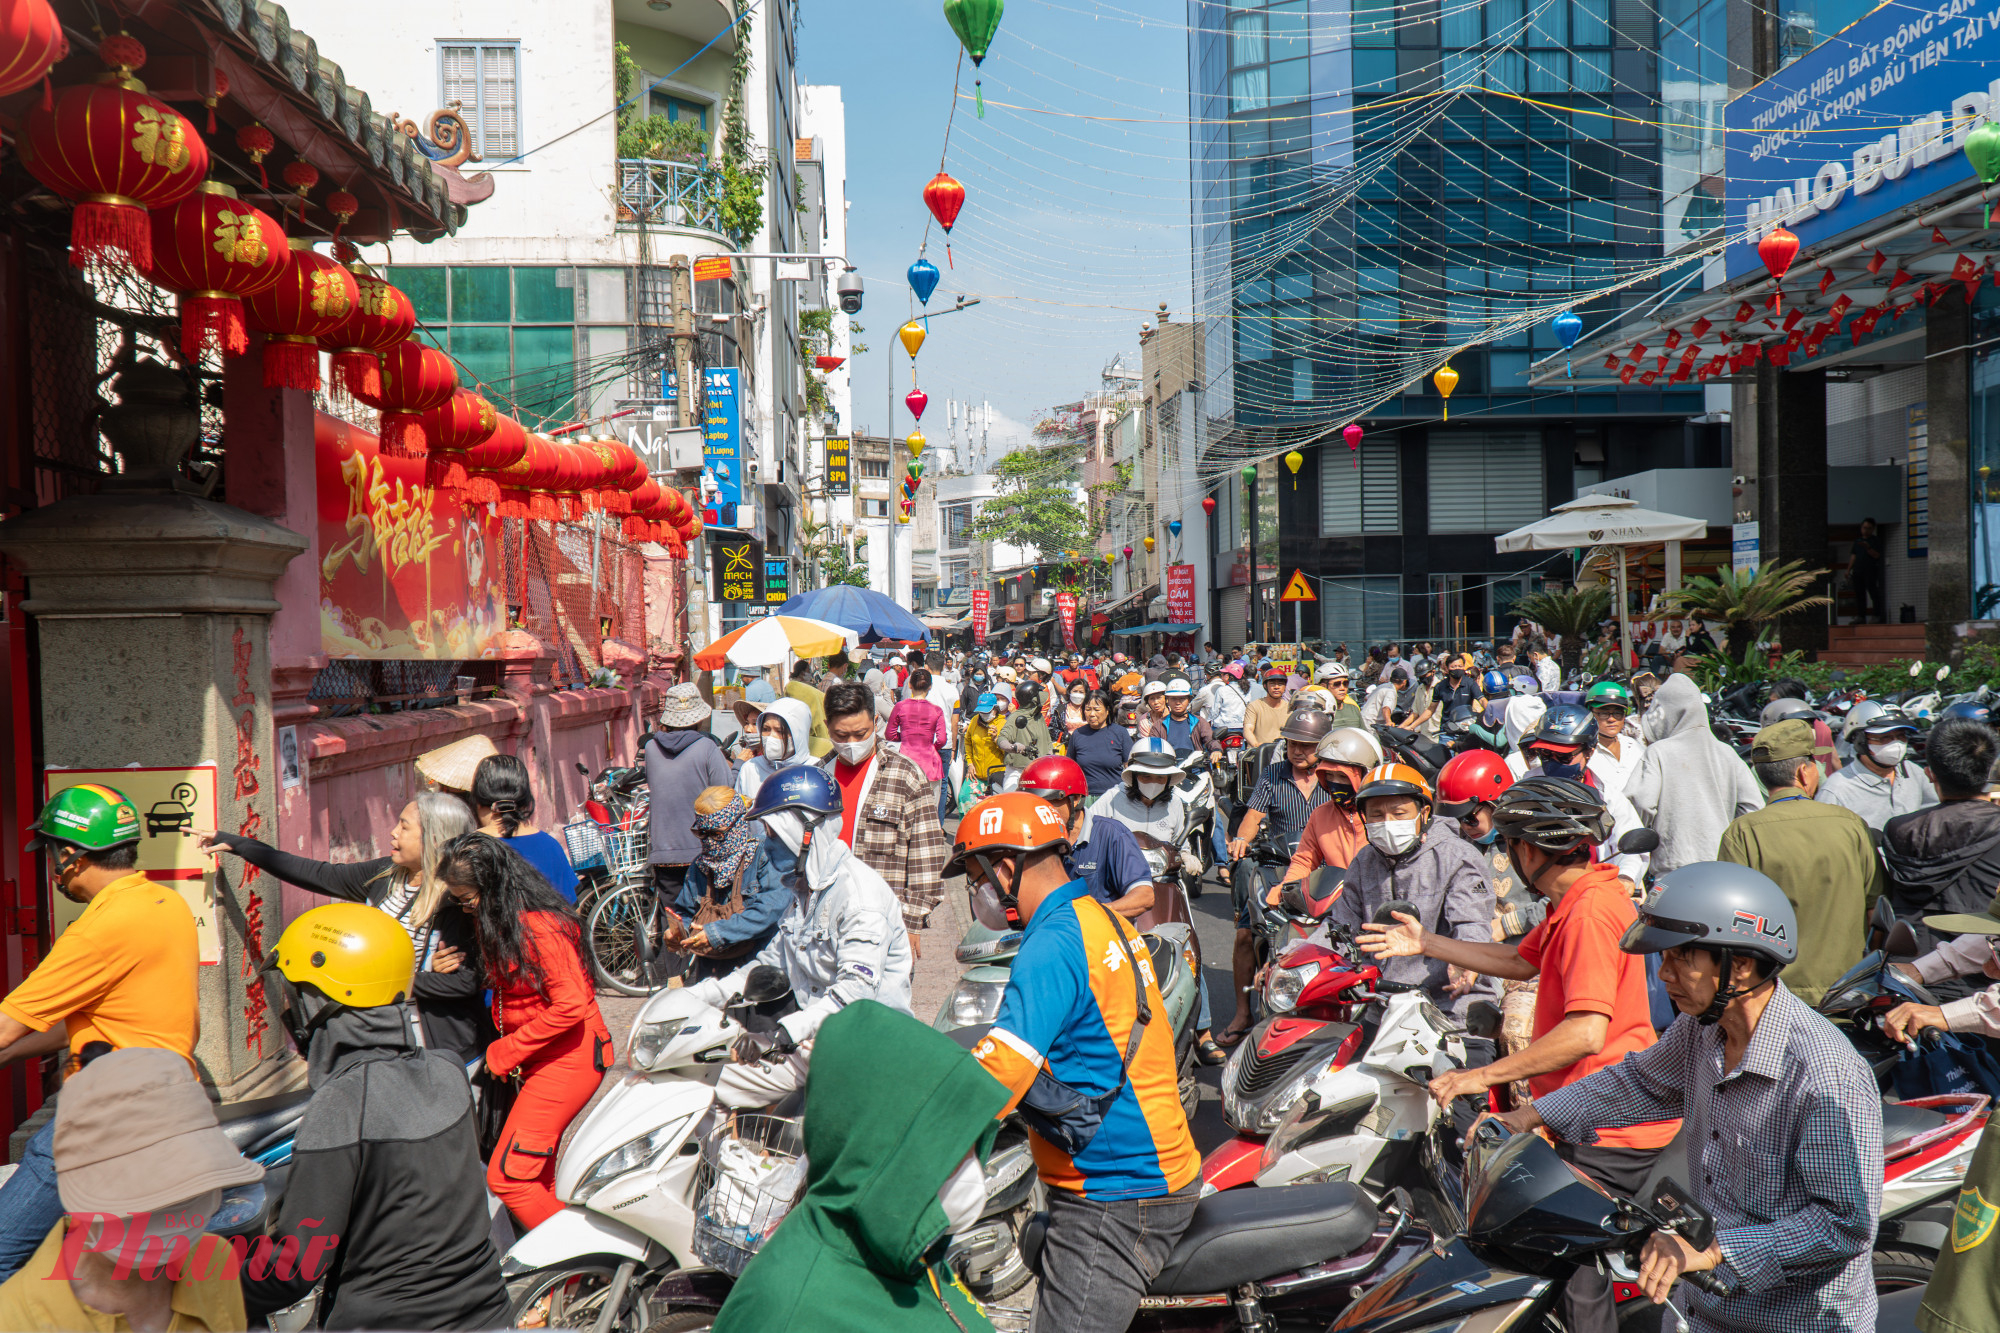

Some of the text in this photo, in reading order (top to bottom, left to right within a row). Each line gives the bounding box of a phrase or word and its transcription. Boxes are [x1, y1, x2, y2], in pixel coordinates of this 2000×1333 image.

[1752, 88, 1807, 132] THƯƠNG
[1811, 65, 1844, 100] HIỆU
[1849, 42, 1880, 78] BẤT
[1883, 12, 1934, 57] ĐỘNG
[1752, 133, 1790, 162] ĐƯỢC
[1793, 111, 1820, 140] LỰA
[1823, 84, 1866, 122] CHỌN
[1869, 61, 1905, 97] ĐẦU
[1909, 36, 1949, 75] TIÊN
[1952, 17, 1983, 49] TẠI
[131, 104, 190, 174] 福
[1747, 161, 1847, 245] HALO
[213, 209, 269, 268] 福
[310, 270, 350, 318] 福
[358, 277, 398, 320] 福
[827, 440, 849, 452] NGỌC
[830, 454, 847, 466] ÁNH
[830, 471, 847, 481] SPA
[1170, 586, 1189, 599] CẤM
[1731, 909, 1788, 941] FILA
[1731, 927, 1788, 948] WATCHES
[612, 1193, 648, 1211] HONDA
